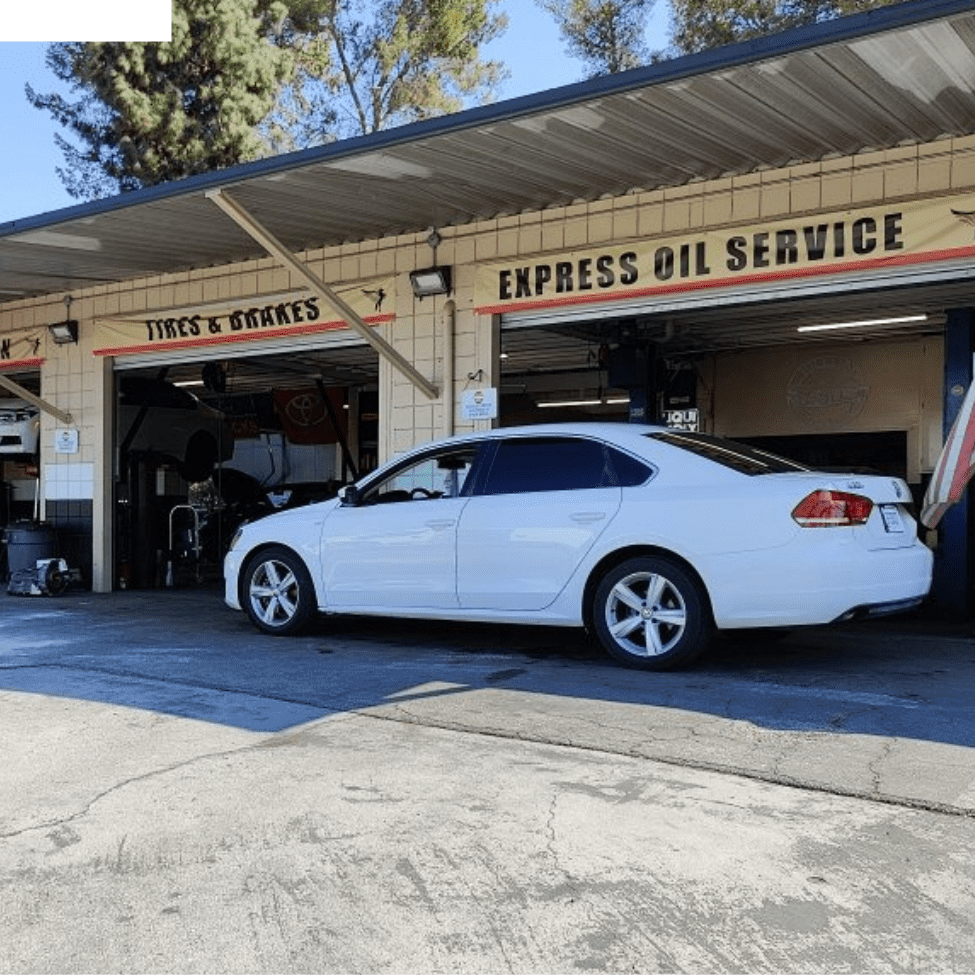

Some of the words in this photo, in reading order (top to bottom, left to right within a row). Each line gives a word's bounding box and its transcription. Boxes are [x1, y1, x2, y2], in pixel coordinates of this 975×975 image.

[499, 252, 639, 300] EXPRESS
[654, 241, 711, 281] OIL
[726, 212, 904, 272] SERVICE
[145, 315, 201, 341] TIRES
[208, 316, 223, 334] &
[228, 297, 321, 331] BRAKES
